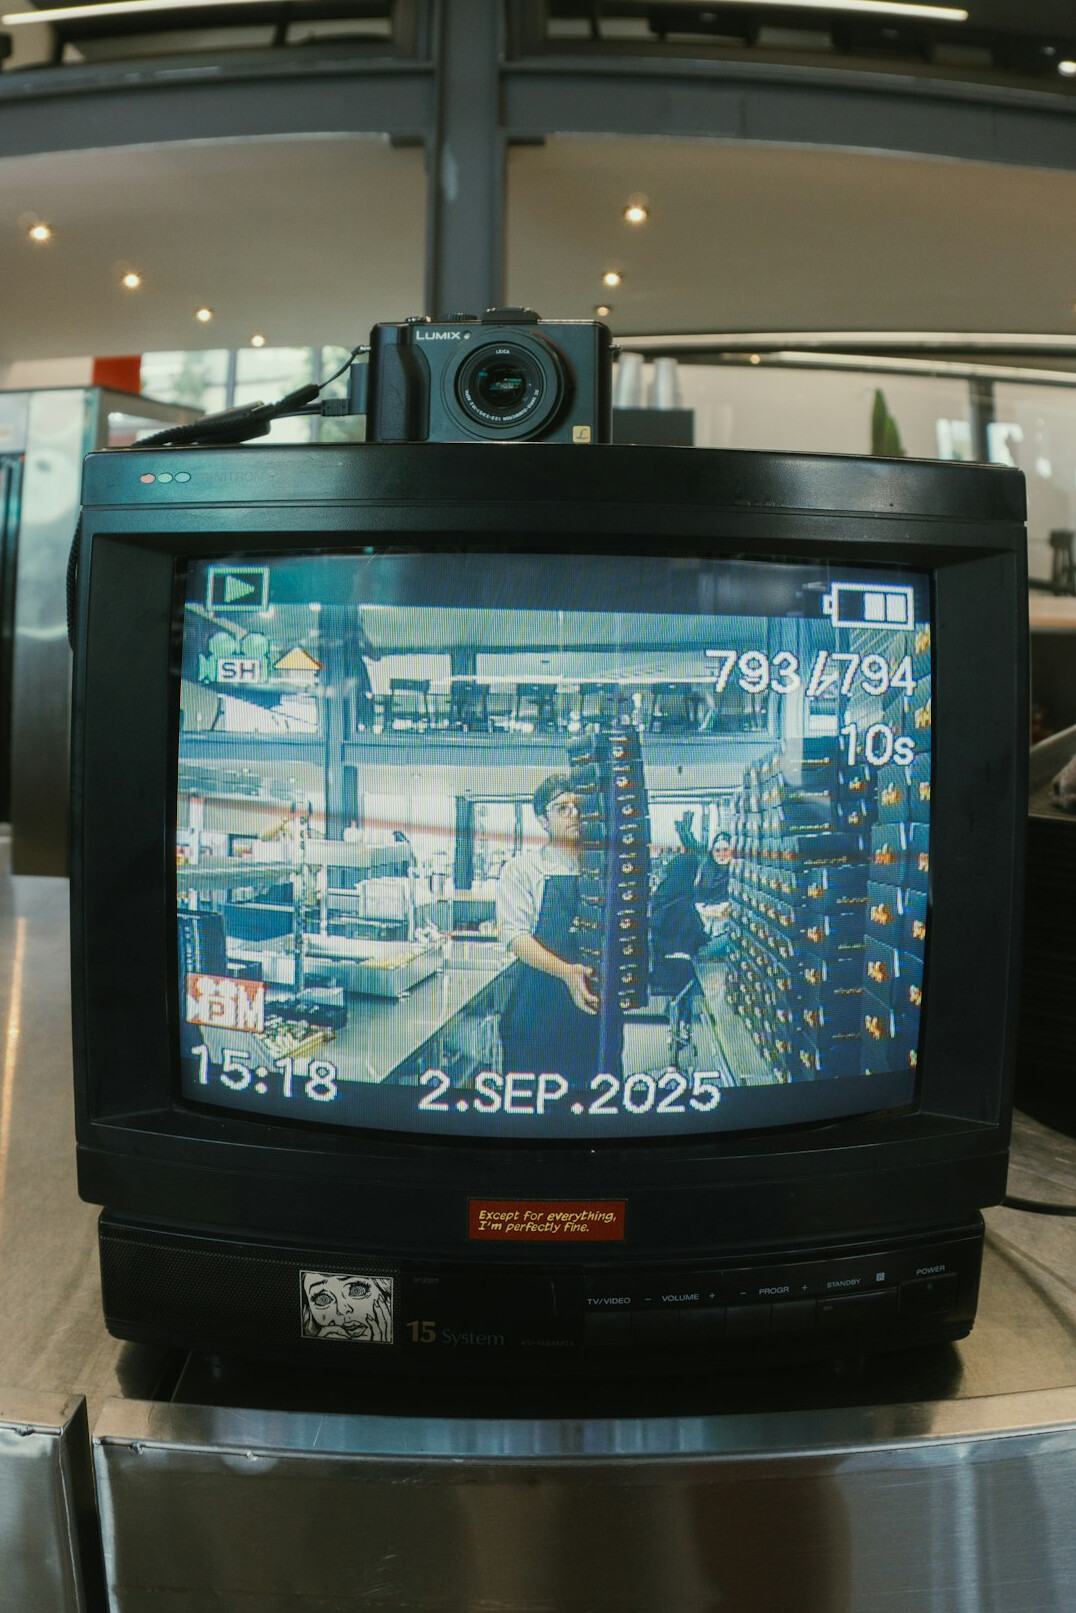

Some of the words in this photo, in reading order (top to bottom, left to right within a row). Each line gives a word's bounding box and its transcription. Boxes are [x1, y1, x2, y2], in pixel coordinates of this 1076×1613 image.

[416, 330, 461, 340] LUMIX
[221, 661, 256, 682] SH
[705, 649, 917, 698] 793/794
[841, 722, 916, 767] 10s
[190, 1045, 338, 1102] 15:18
[417, 1070, 722, 1114] 2.SEP.2025
[478, 1210, 519, 1222] Except
[523, 1210, 544, 1221] for
[546, 1210, 617, 1224] everything,
[478, 1220, 503, 1231] I'm
[505, 1221, 561, 1233] perfectly
[563, 1221, 590, 1233] fine.
[916, 1265, 946, 1276] POWER
[826, 1278, 862, 1289] STANDBY
[661, 1292, 700, 1303] VOLUME
[758, 1286, 790, 1296] PROGR
[587, 1296, 632, 1306] TV/VIDEO
[405, 1319, 437, 1344] 15
[441, 1327, 506, 1349] System
